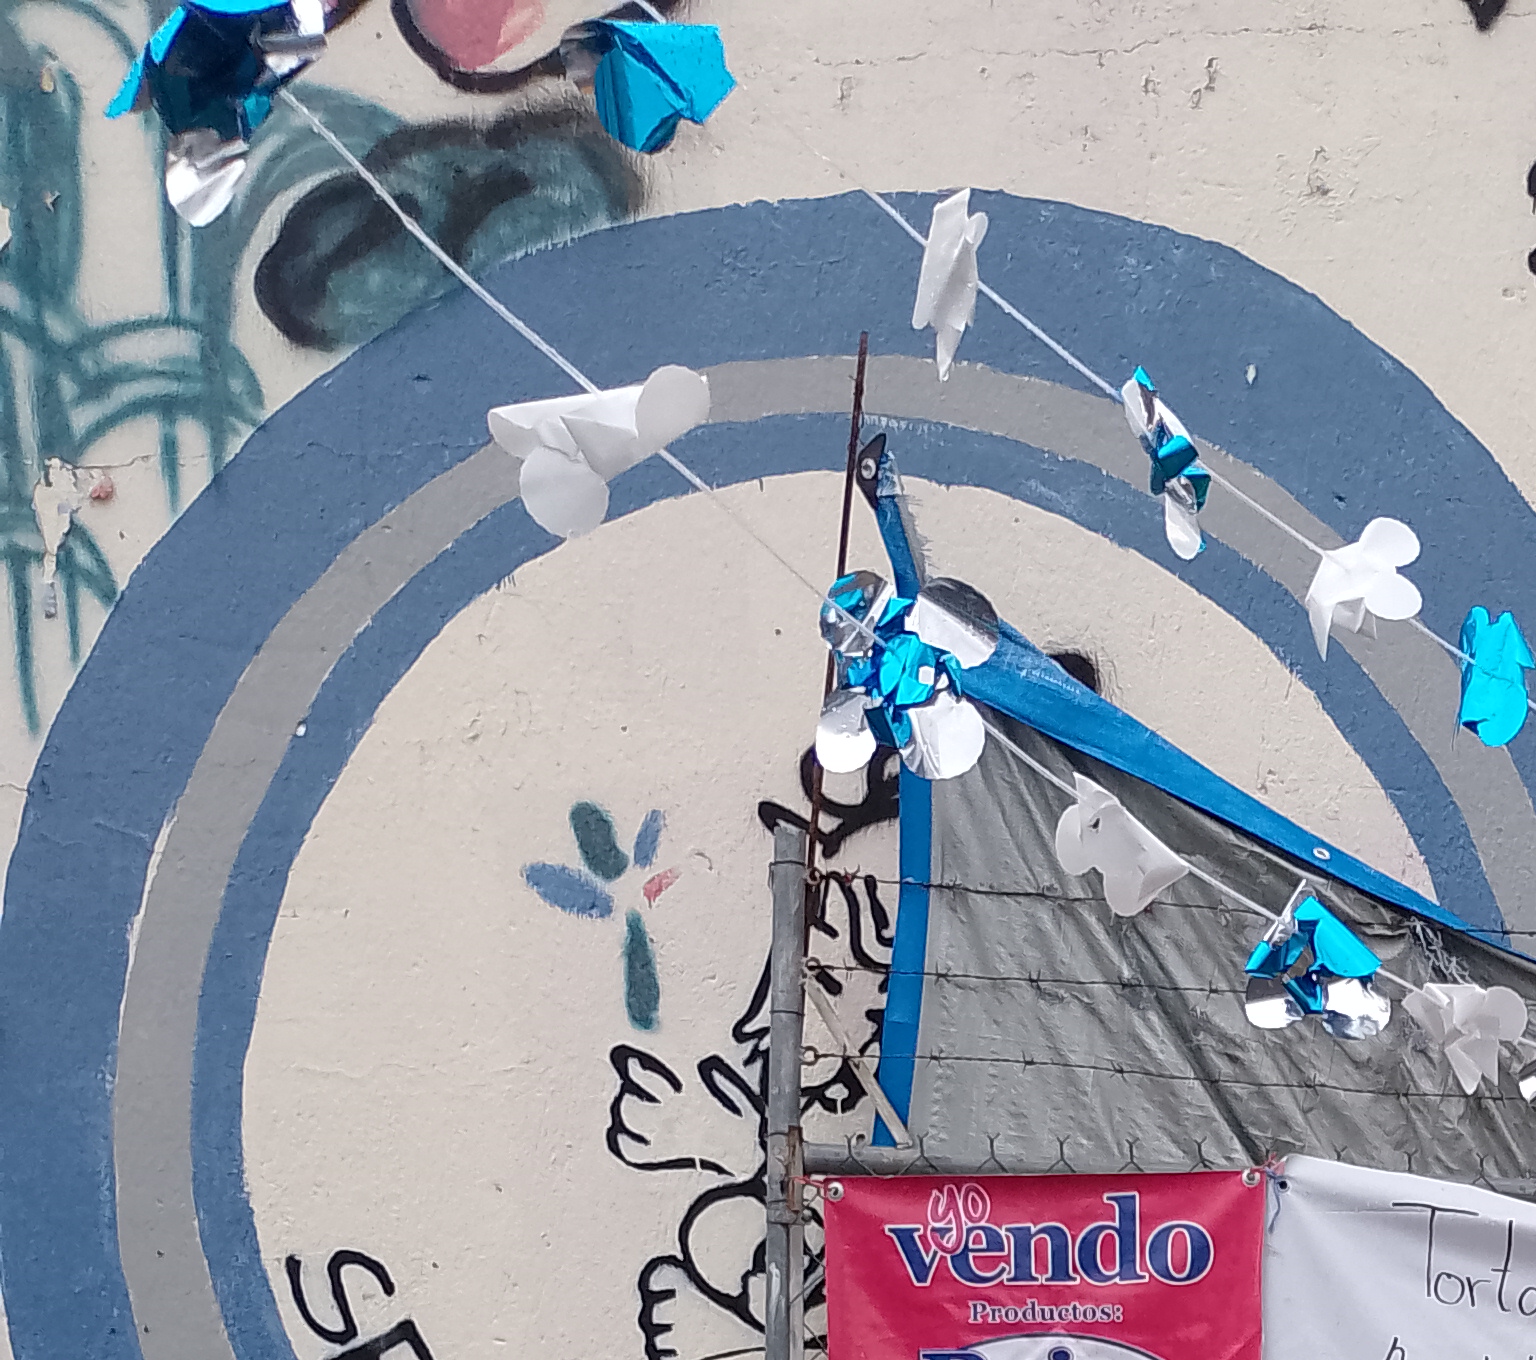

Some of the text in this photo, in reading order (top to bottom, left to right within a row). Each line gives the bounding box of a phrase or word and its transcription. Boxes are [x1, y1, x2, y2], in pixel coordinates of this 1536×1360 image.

[885, 1192, 1214, 1287] vendo
[928, 1183, 990, 1254] yo
[968, 1298, 1125, 1324] Productos:
